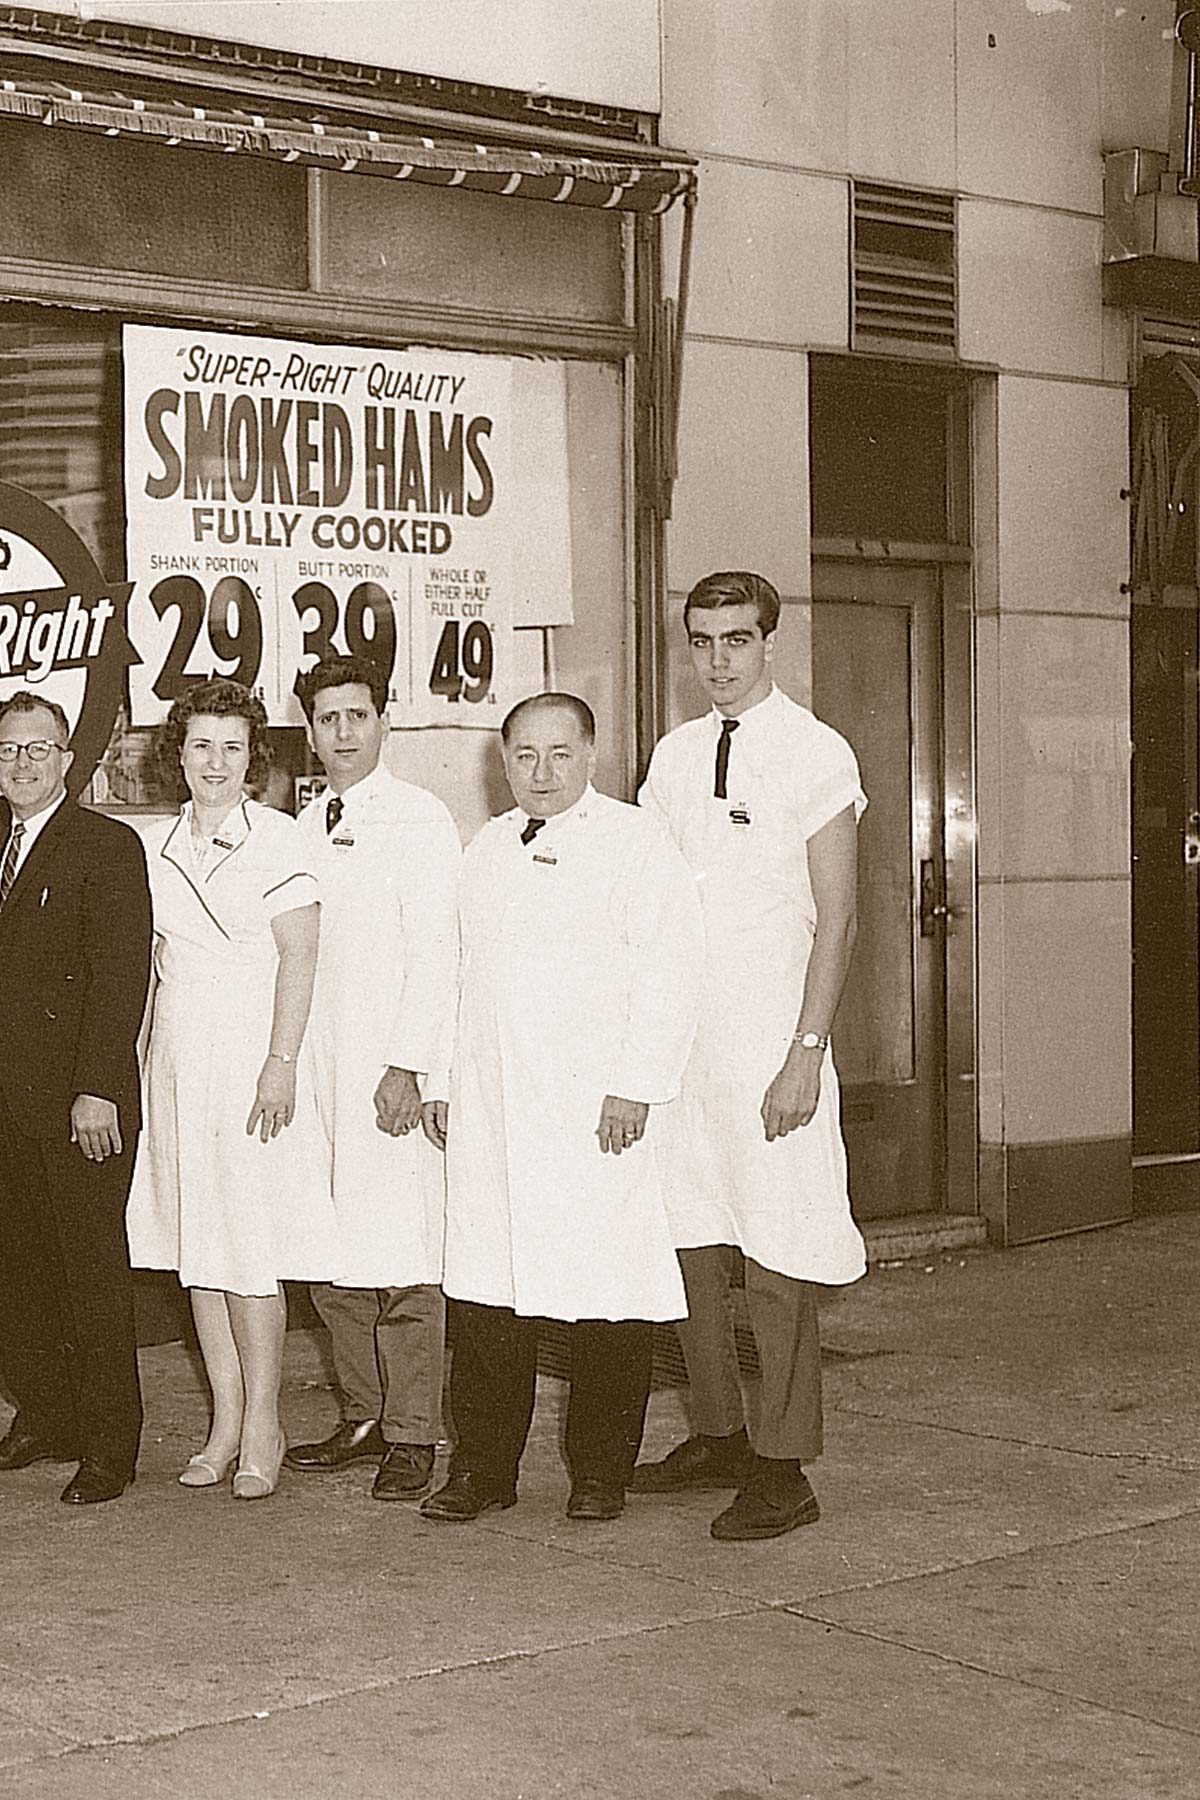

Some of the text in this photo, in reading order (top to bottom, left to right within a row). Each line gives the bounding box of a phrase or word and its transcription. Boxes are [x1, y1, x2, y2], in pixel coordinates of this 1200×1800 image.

[367, 362, 466, 405] QUALITY
[144, 387, 494, 518] SMOKED HAMS
[192, 507, 452, 555] FULLY COOKED
[150, 554, 259, 574] SHANK PORTION
[299, 561, 390, 579] BUTT PORTION
[429, 568, 487, 584] WHOLE OR
[425, 584, 492, 601] EITHER HALF
[431, 602, 485, 617] FULL CUT
[148, 574, 263, 701] 29
[428, 620, 493, 703] 49
